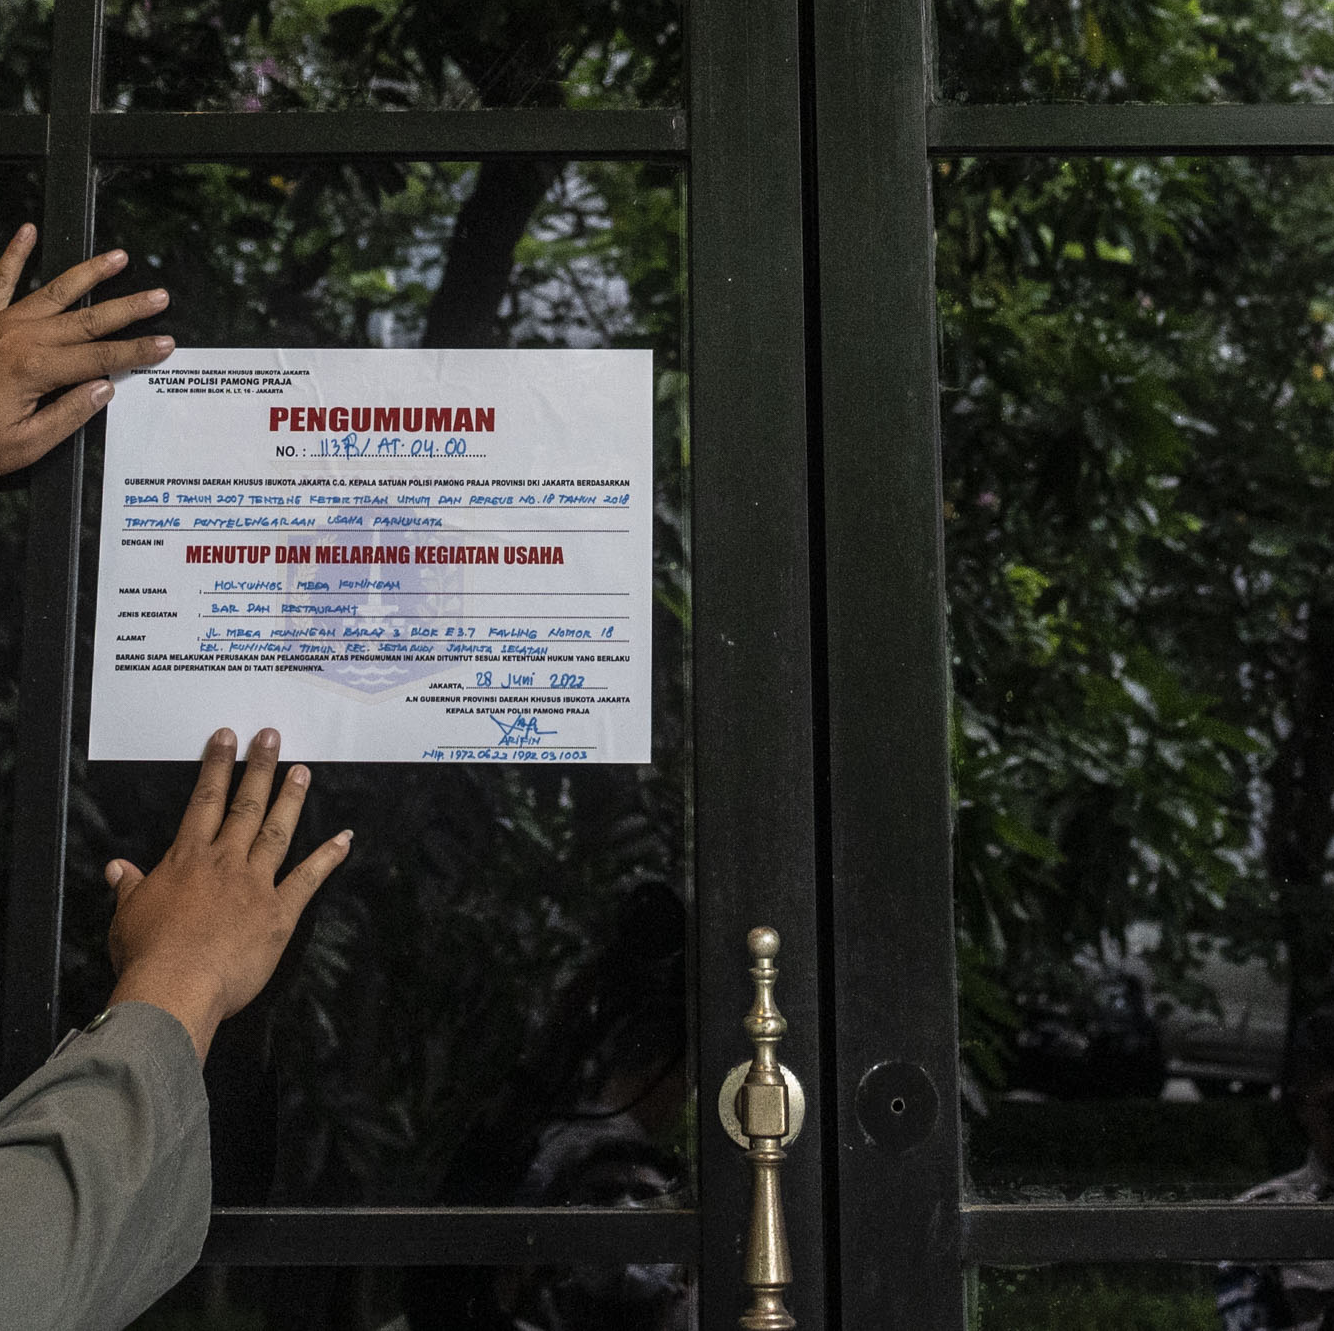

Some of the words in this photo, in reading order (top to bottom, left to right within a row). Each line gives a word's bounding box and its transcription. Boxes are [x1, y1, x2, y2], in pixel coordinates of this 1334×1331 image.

[148, 377, 186, 386] SATUAN
[188, 377, 218, 386] POLISI
[220, 377, 260, 386] PAMONG
[262, 377, 292, 386] PRAJA
[269, 407, 496, 432] PENGUMUMAN
[276, 446, 298, 458] NO.
[378, 479, 407, 487] SATUAN
[408, 479, 432, 487] POLISI
[434, 479, 464, 487] PAMONG
[466, 479, 490, 487] PRAJA
[492, 479, 525, 487] PROVINSI
[527, 479, 540, 487] DKI
[542, 479, 575, 487] JAKARTA
[576, 479, 630, 487] BERDASARKAN
[163, 492, 170, 504] 8
[176, 495, 212, 504] TAHUN
[217, 494, 244, 507] 2007
[248, 495, 301, 506] TENTANG
[438, 496, 462, 505] DAN
[558, 494, 596, 505] TAHUN
[603, 494, 630, 505] 2018
[185, 545, 271, 564] MENUTUP
[275, 545, 311, 564] DAN
[315, 545, 410, 564] MELARANG
[414, 546, 500, 565] KEGIATAN
[504, 546, 564, 565] USAHA
[211, 604, 239, 613] BAR
[246, 603, 270, 614] DAN
[475, 671, 493, 687] 28
